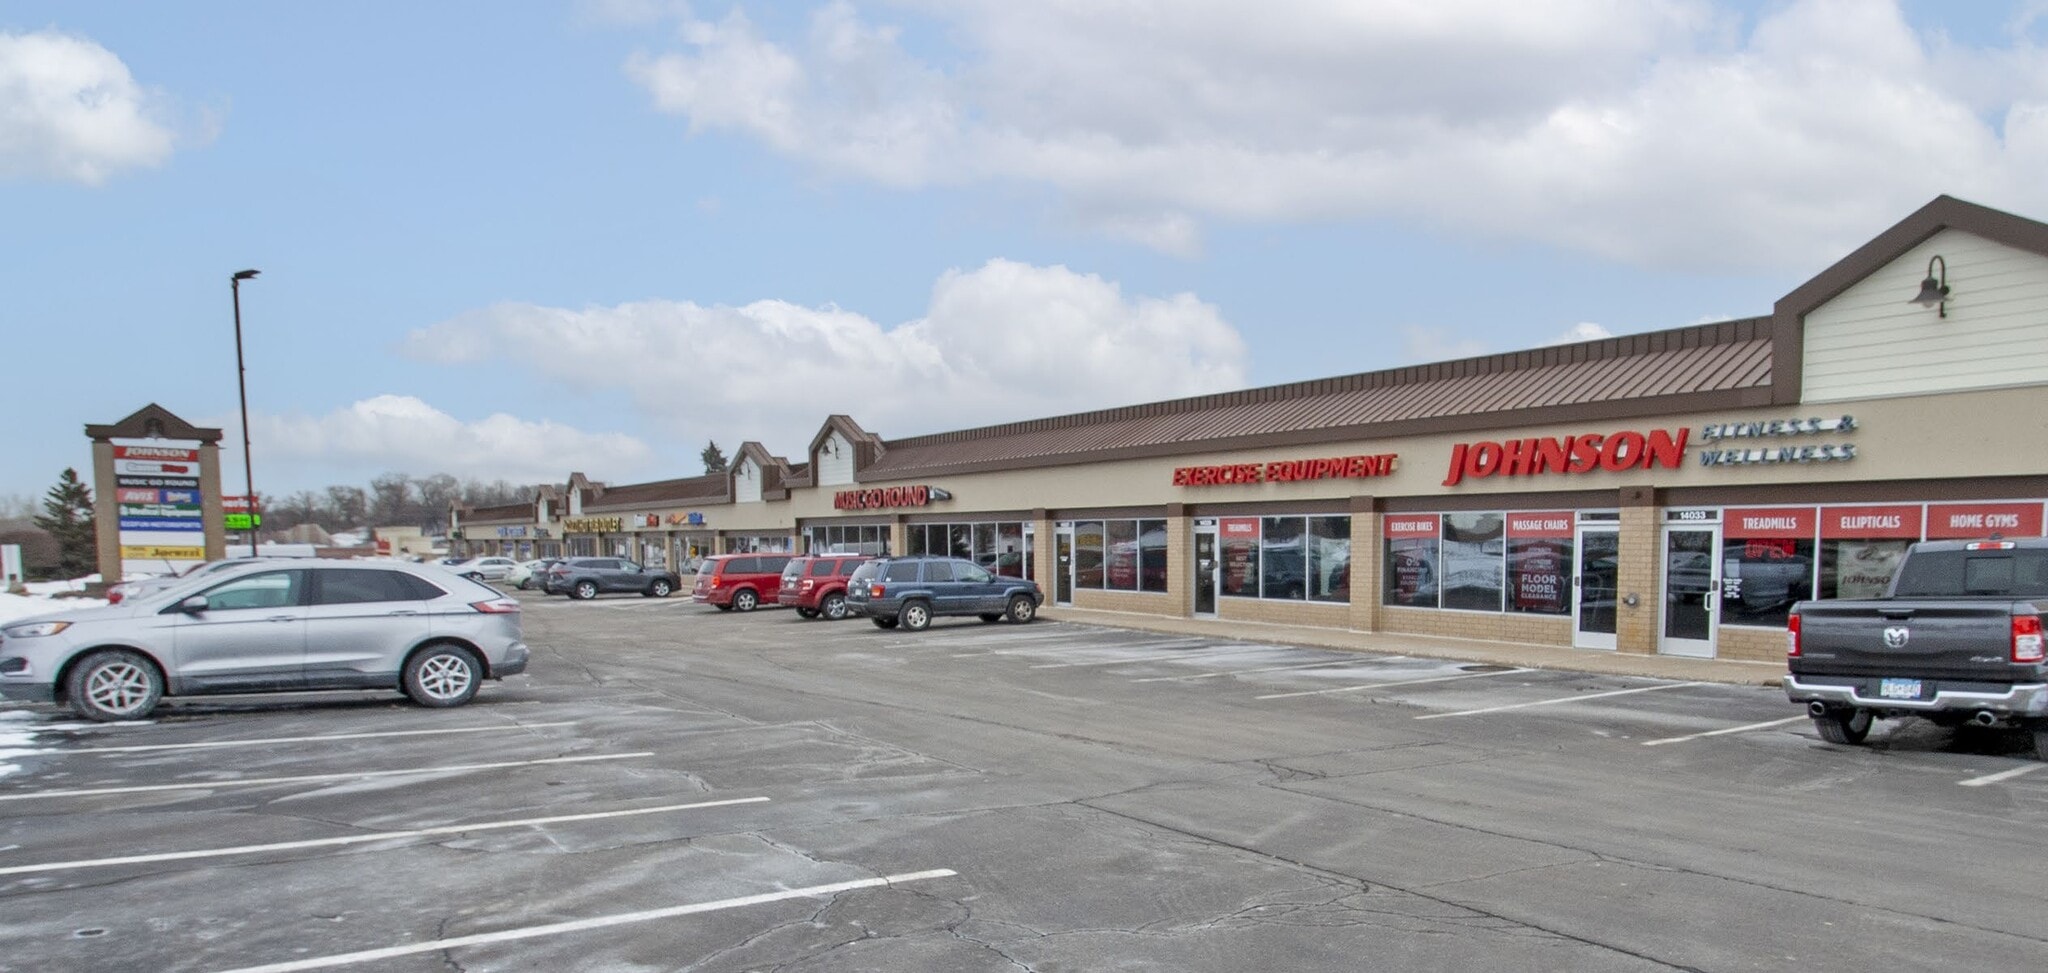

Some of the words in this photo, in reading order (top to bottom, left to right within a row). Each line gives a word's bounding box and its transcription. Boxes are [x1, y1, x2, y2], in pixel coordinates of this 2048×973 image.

[1701, 417, 1821, 440] FITNESS
[1835, 414, 1855, 433] &
[124, 447, 190, 458] JOHNSON
[1441, 427, 1690, 487] JOHNSON
[1699, 443, 1856, 467] WELLNESS
[1172, 463, 1263, 486] EXERCISE
[1264, 453, 1398, 482] EQUIPMENT
[119, 478, 148, 487] MUSIC
[148, 478, 164, 487] GO
[164, 479, 198, 488] ROUND
[834, 490, 863, 509] MUSIC
[864, 487, 884, 508] GO
[884, 485, 929, 507] ROUND
[1680, 511, 1706, 520] 14033
[1840, 515, 1901, 529] ELLIPTICALS
[1950, 514, 1983, 528] HOME
[1985, 513, 2019, 528] GYMS
[1391, 522, 1416, 532] EXERCISE
[1416, 521, 1433, 532] BIKES
[1513, 520, 1543, 531] MASSAGE
[1543, 519, 1569, 531] CHAIRS
[1743, 517, 1797, 530] TREADMILLS
[1521, 574, 1557, 584] FLOOR
[1521, 584, 1557, 593] MODEL
